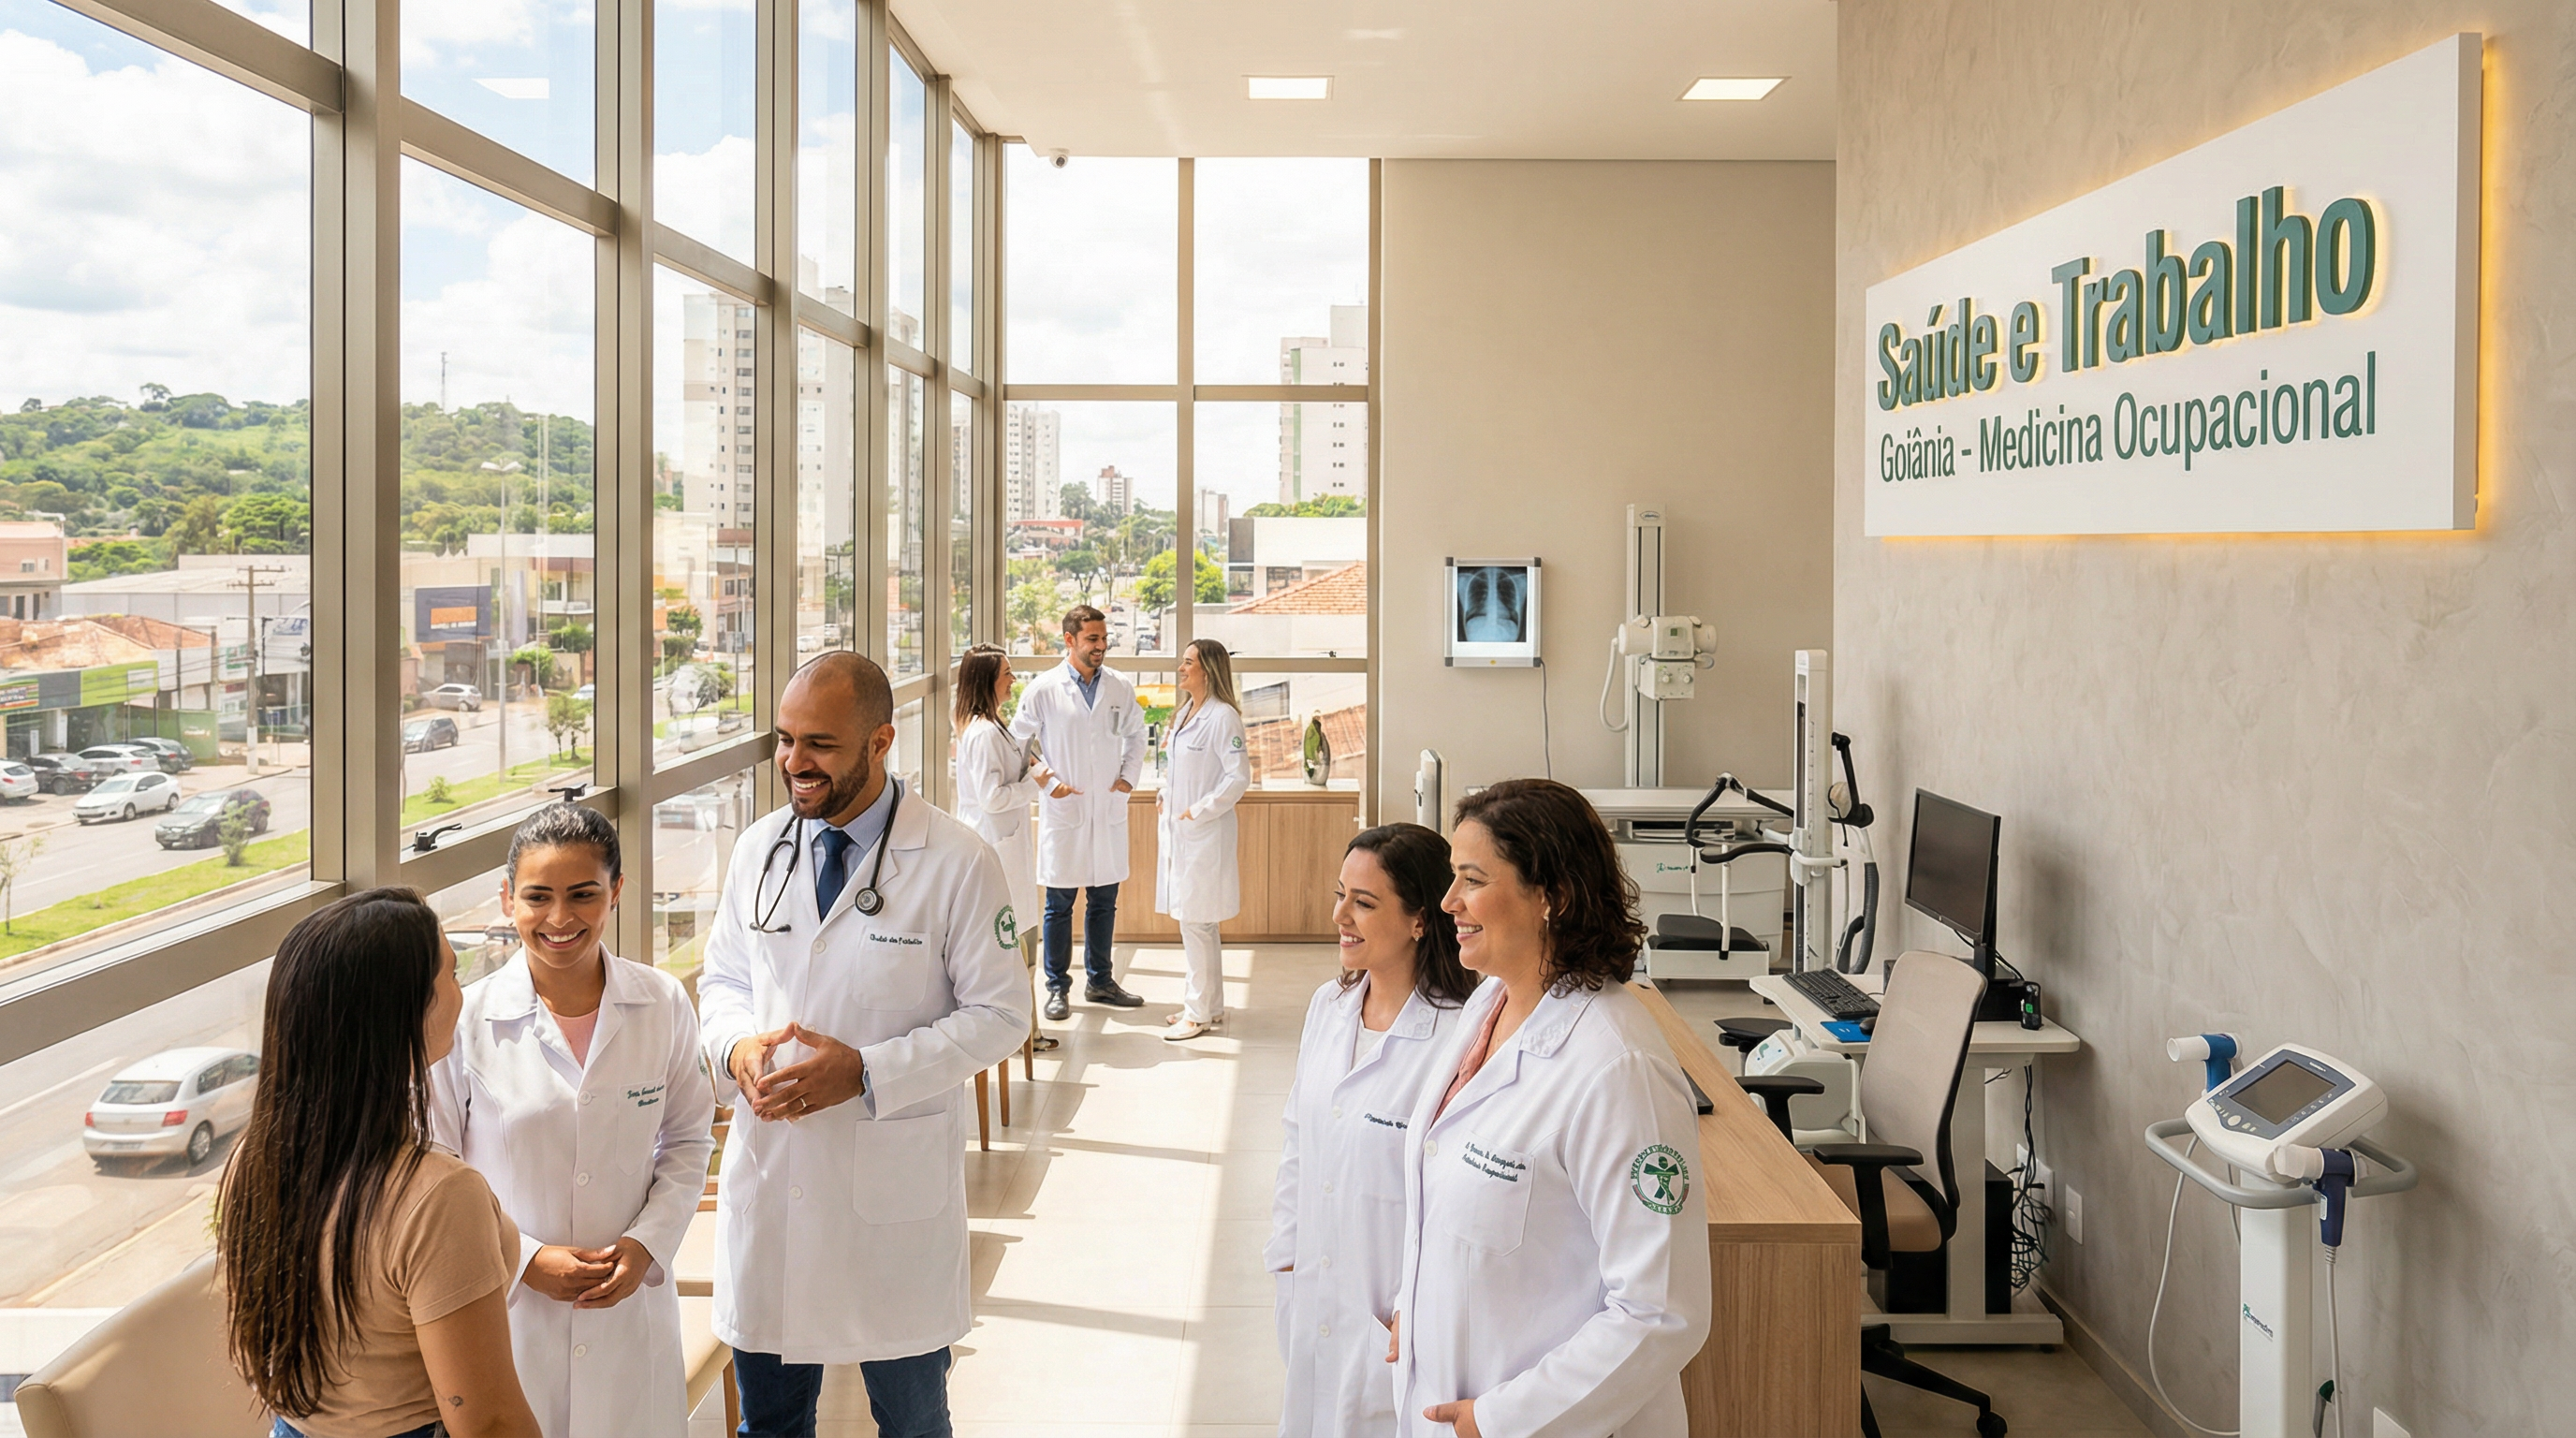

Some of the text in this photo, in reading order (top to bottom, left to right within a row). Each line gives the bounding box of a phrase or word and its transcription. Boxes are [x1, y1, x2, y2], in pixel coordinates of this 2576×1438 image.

[1877, 185, 2376, 411] Saúde e Trabalho
[1880, 350, 2377, 483] Goiânia - Medicina Ocupacional
